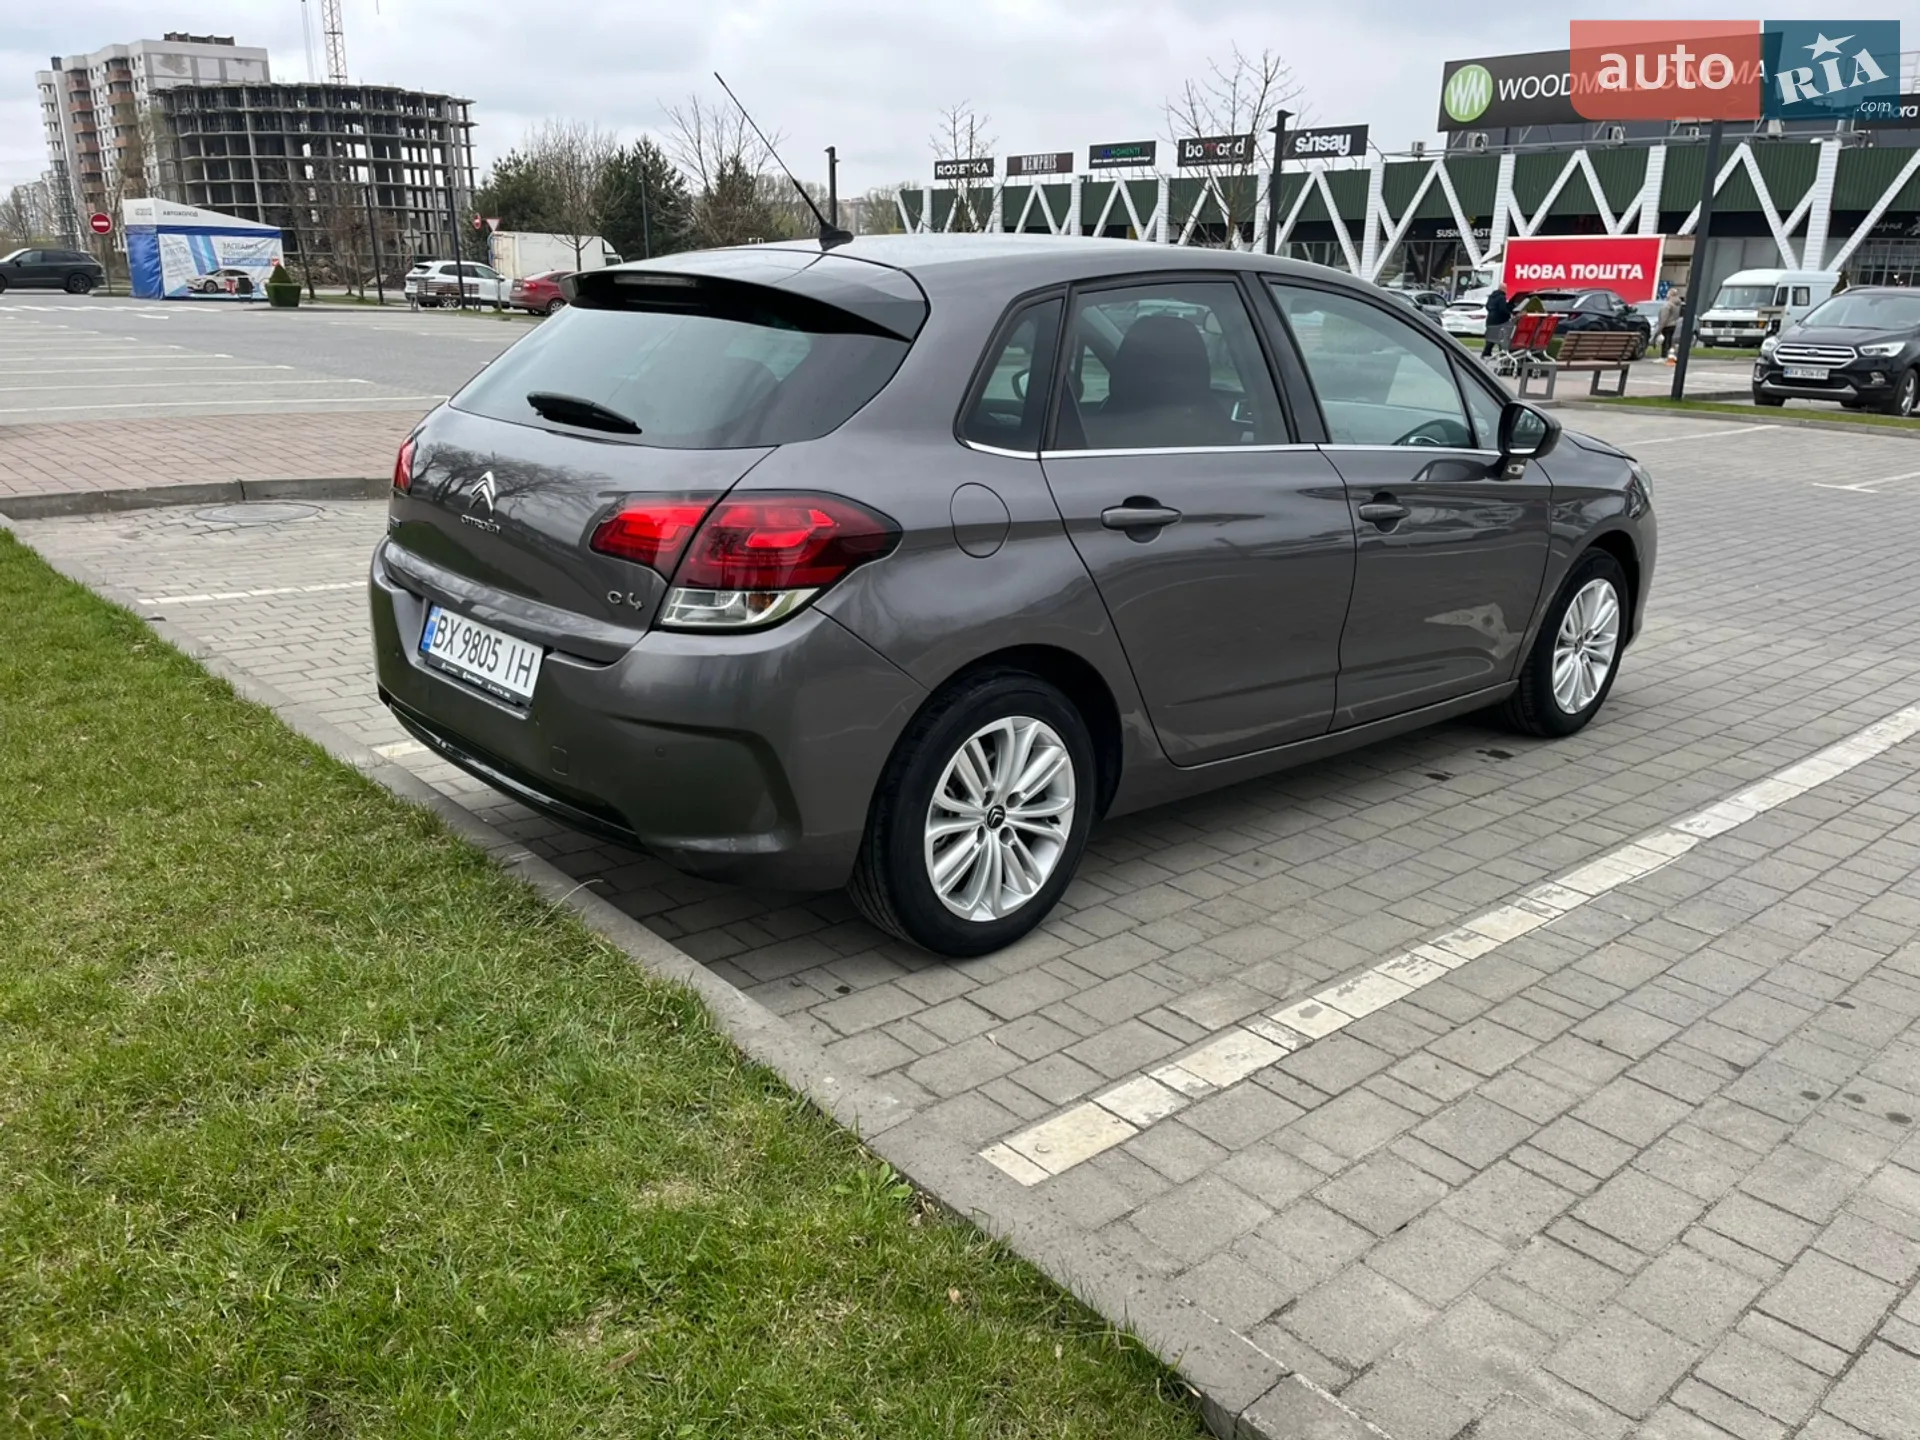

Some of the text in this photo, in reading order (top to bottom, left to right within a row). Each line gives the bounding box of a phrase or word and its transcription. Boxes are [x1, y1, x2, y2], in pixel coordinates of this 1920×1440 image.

[1660, 59, 1769, 90] CNEMA
[1294, 132, 1352, 156] sinsay
[1514, 263, 1644, 280] НОВА ПОШТА
[606, 590, 643, 611] C4
[432, 613, 536, 689] BX 9805 IH
